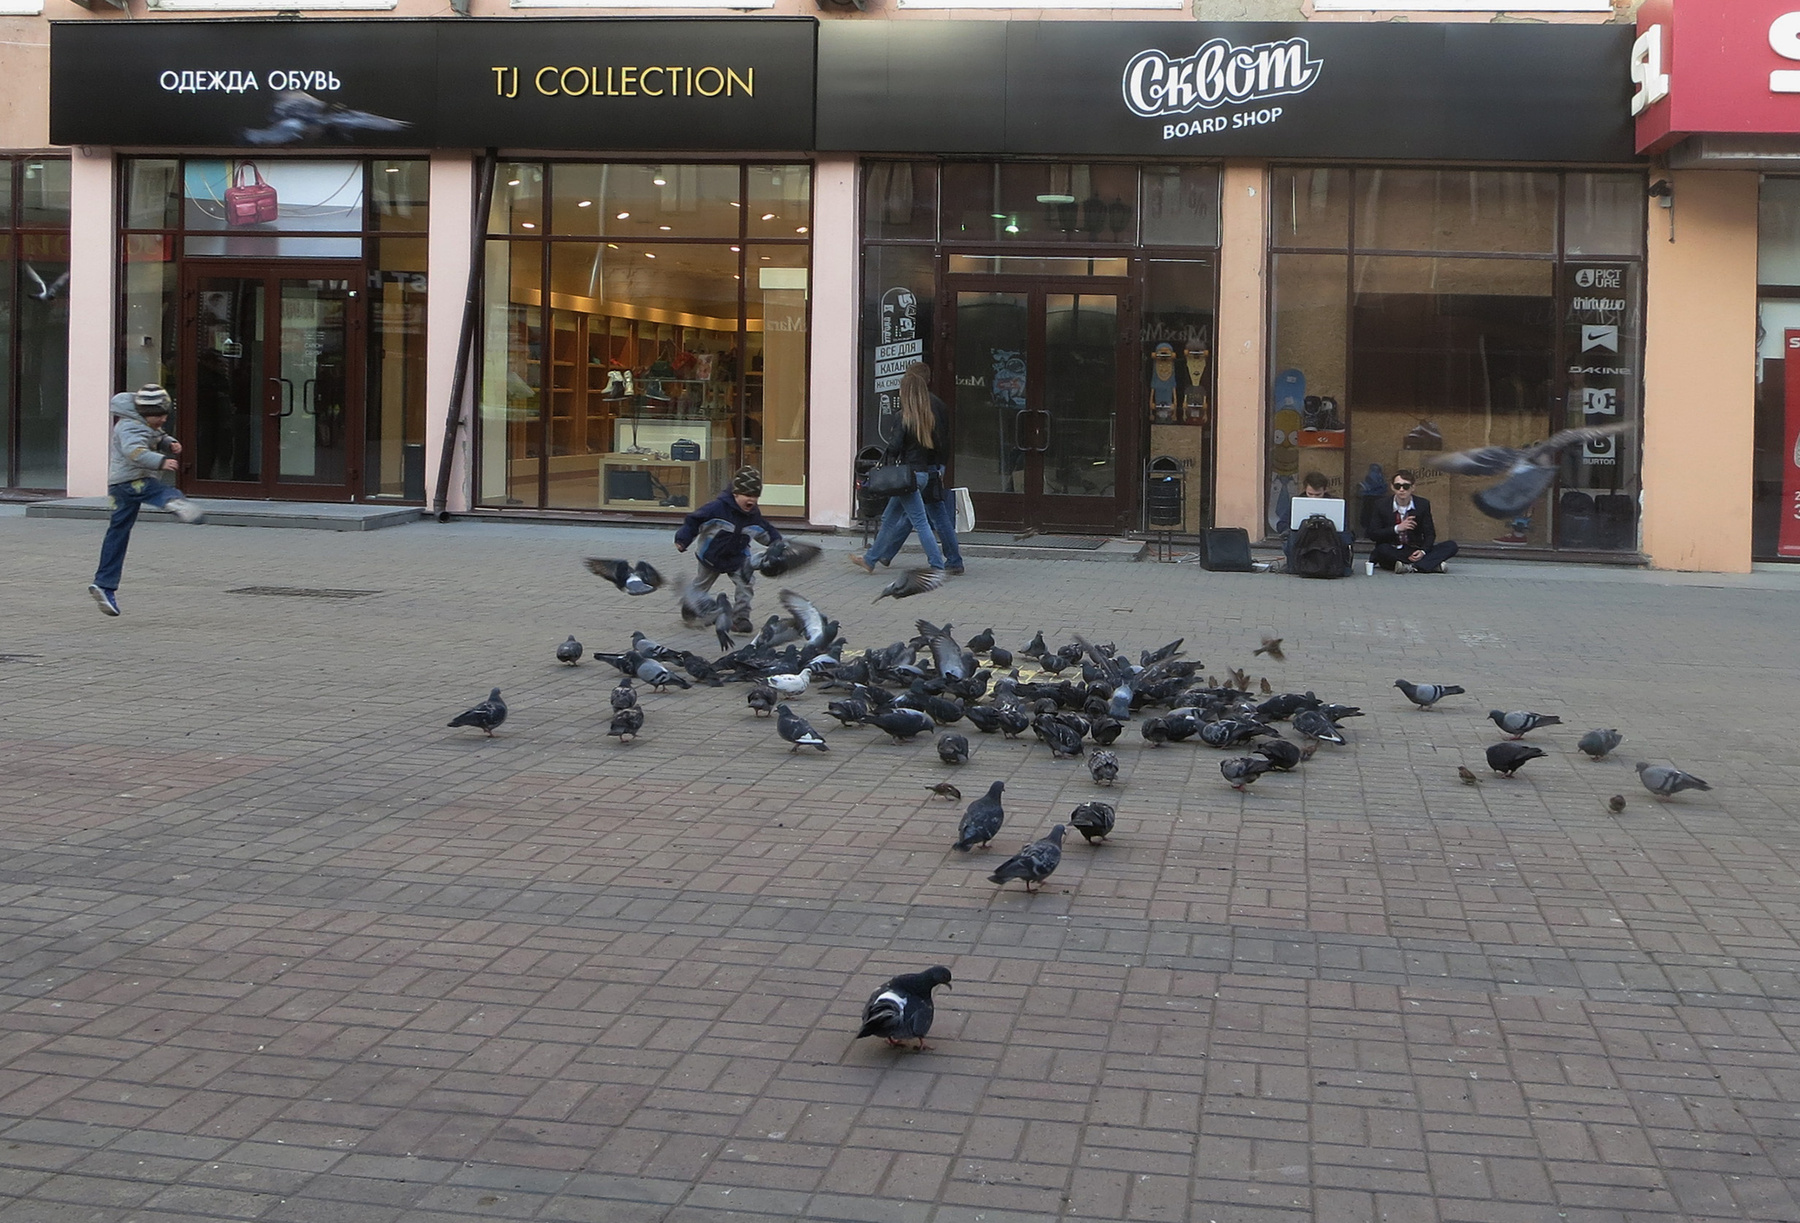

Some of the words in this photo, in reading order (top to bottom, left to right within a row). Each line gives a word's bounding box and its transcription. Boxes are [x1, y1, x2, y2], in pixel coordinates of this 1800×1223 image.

[160, 70, 259, 94] ОДЕЖДА
[267, 70, 342, 91] ОБУВЬ
[491, 66, 518, 98] TJ
[535, 66, 755, 98] COLLECTION
[1163, 116, 1228, 140] BOARD
[1232, 107, 1284, 129] SHOP
[1595, 269, 1622, 279] PICT
[1595, 279, 1621, 289] URE
[880, 346, 897, 358] ВСЕ
[898, 343, 916, 356] ДЛЯ
[1568, 366, 1632, 375] DAKINE
[876, 381, 886, 390] НА
